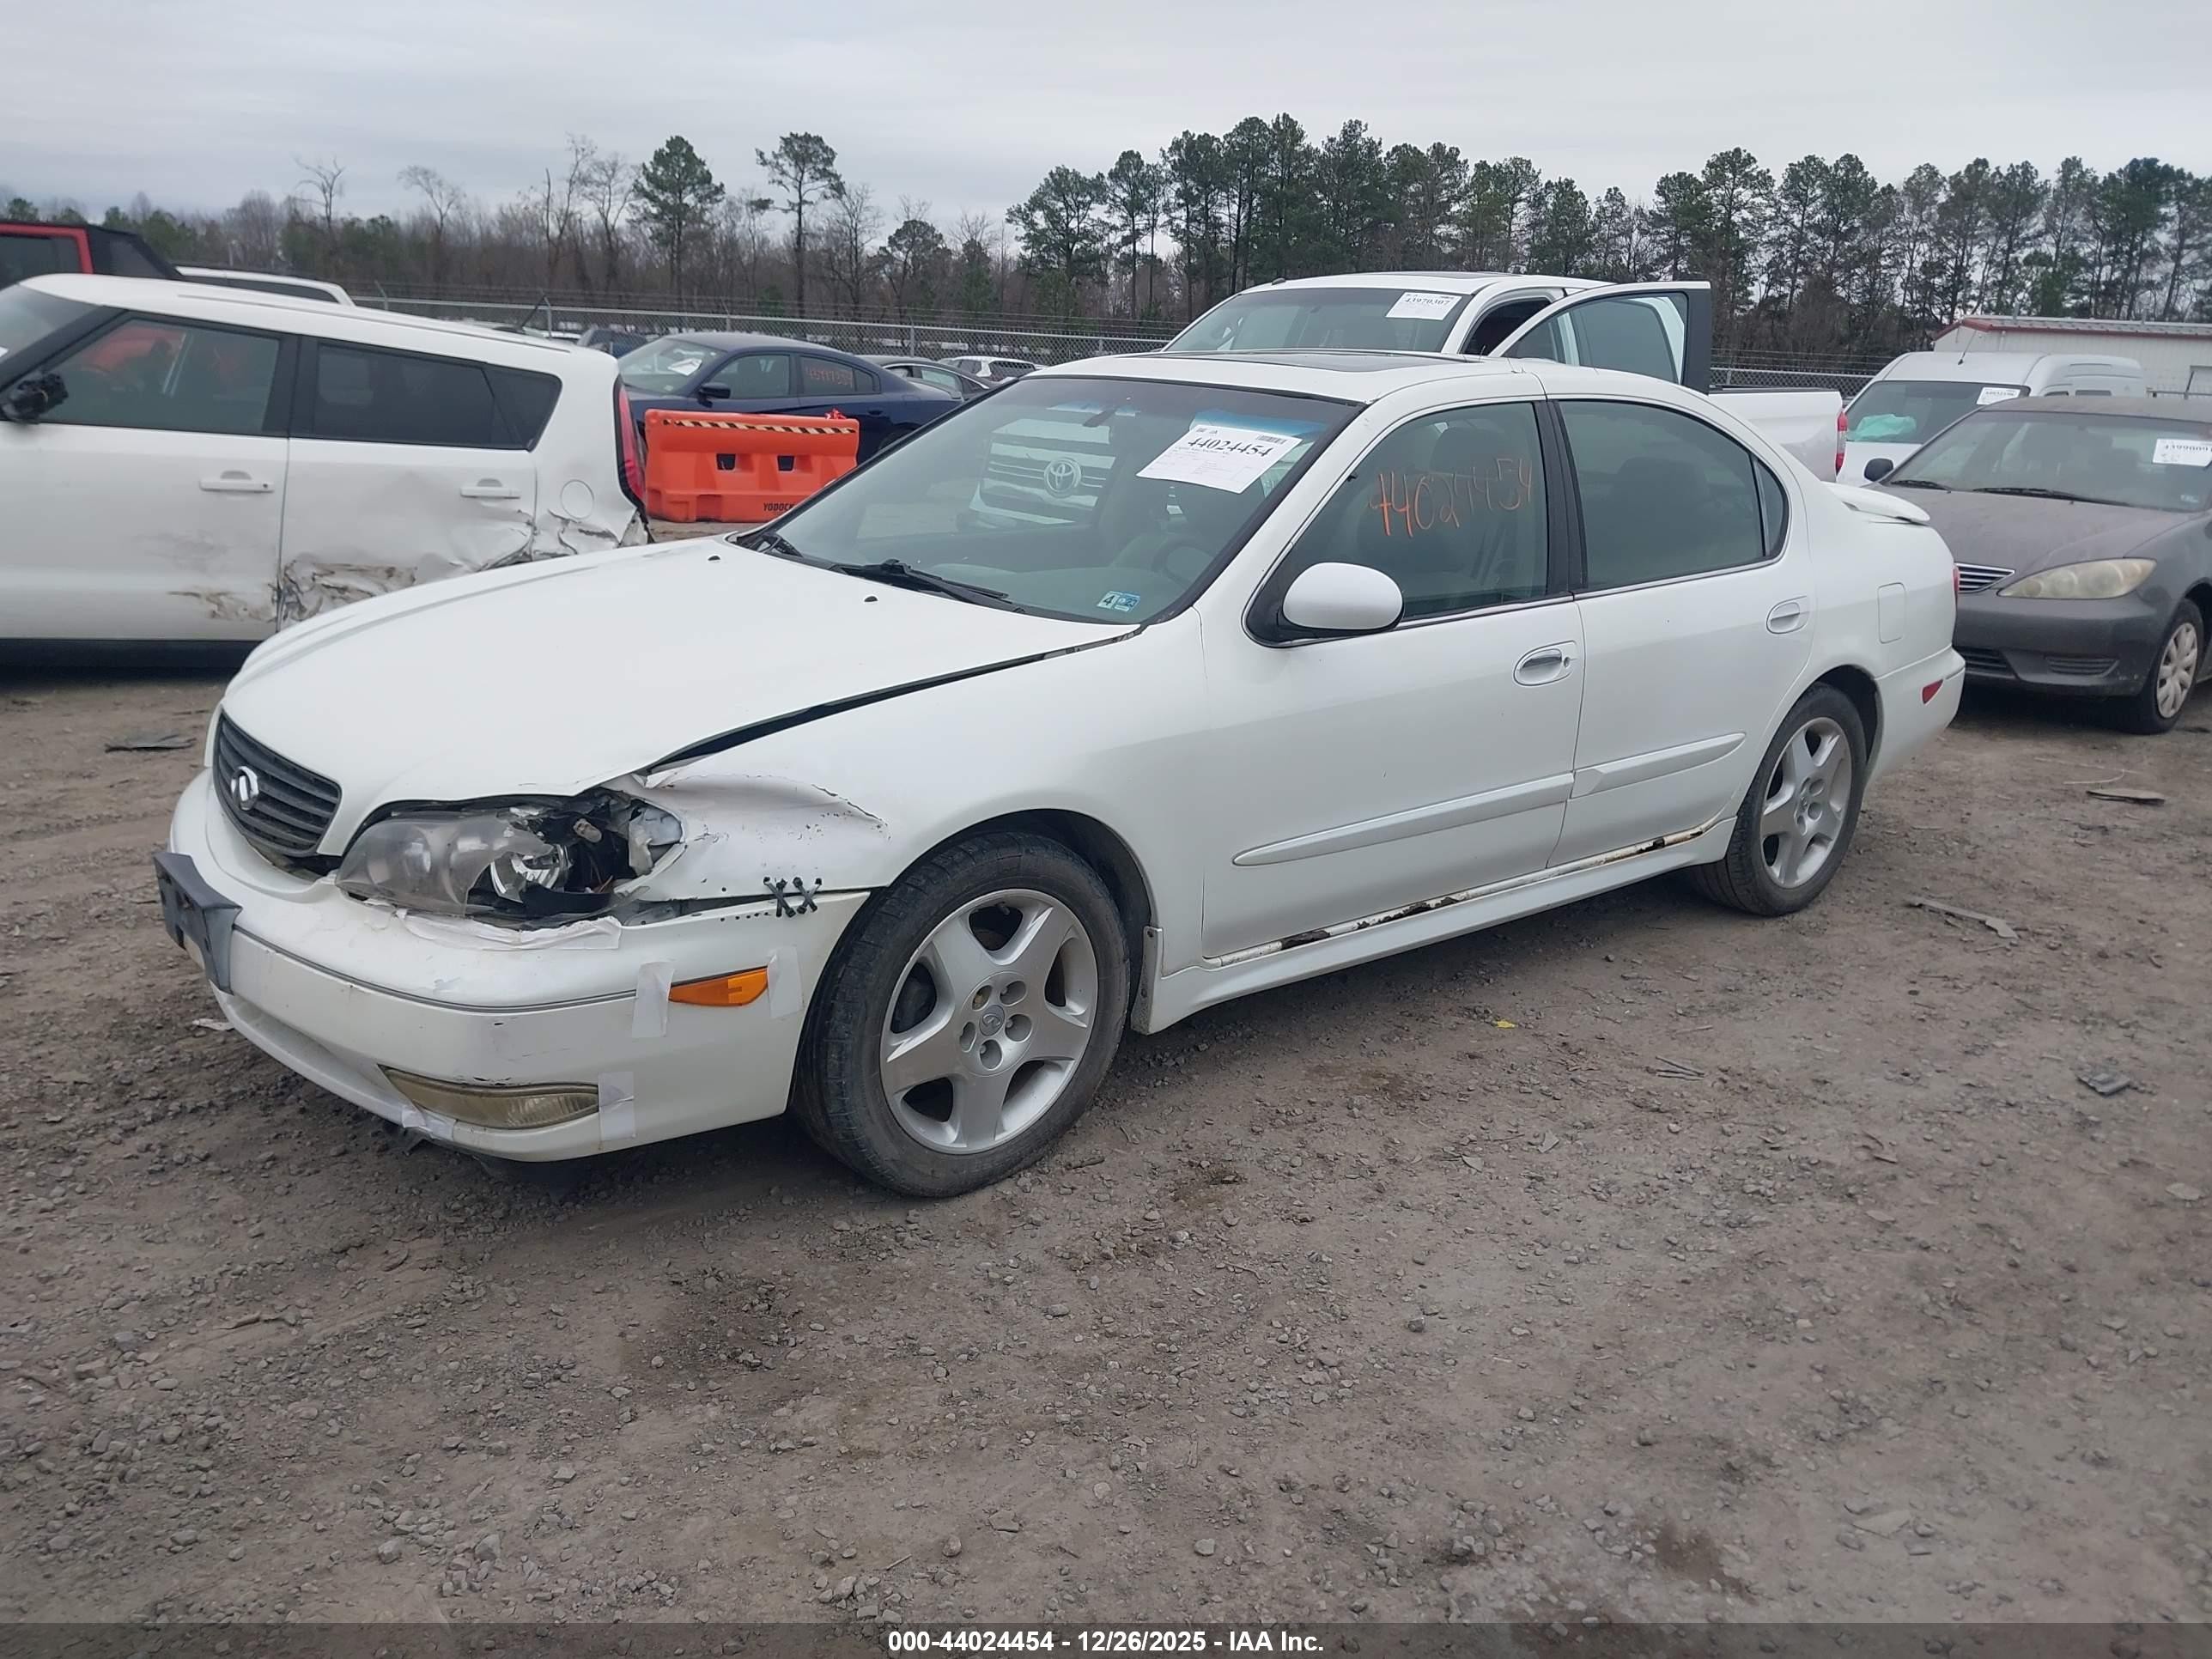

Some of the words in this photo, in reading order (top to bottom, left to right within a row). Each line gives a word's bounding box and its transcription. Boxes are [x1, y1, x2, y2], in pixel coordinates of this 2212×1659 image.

[1188, 437, 1273, 457] 44024454
[1369, 458, 1533, 538] 44024454
[1103, 595, 1115, 605] 4
